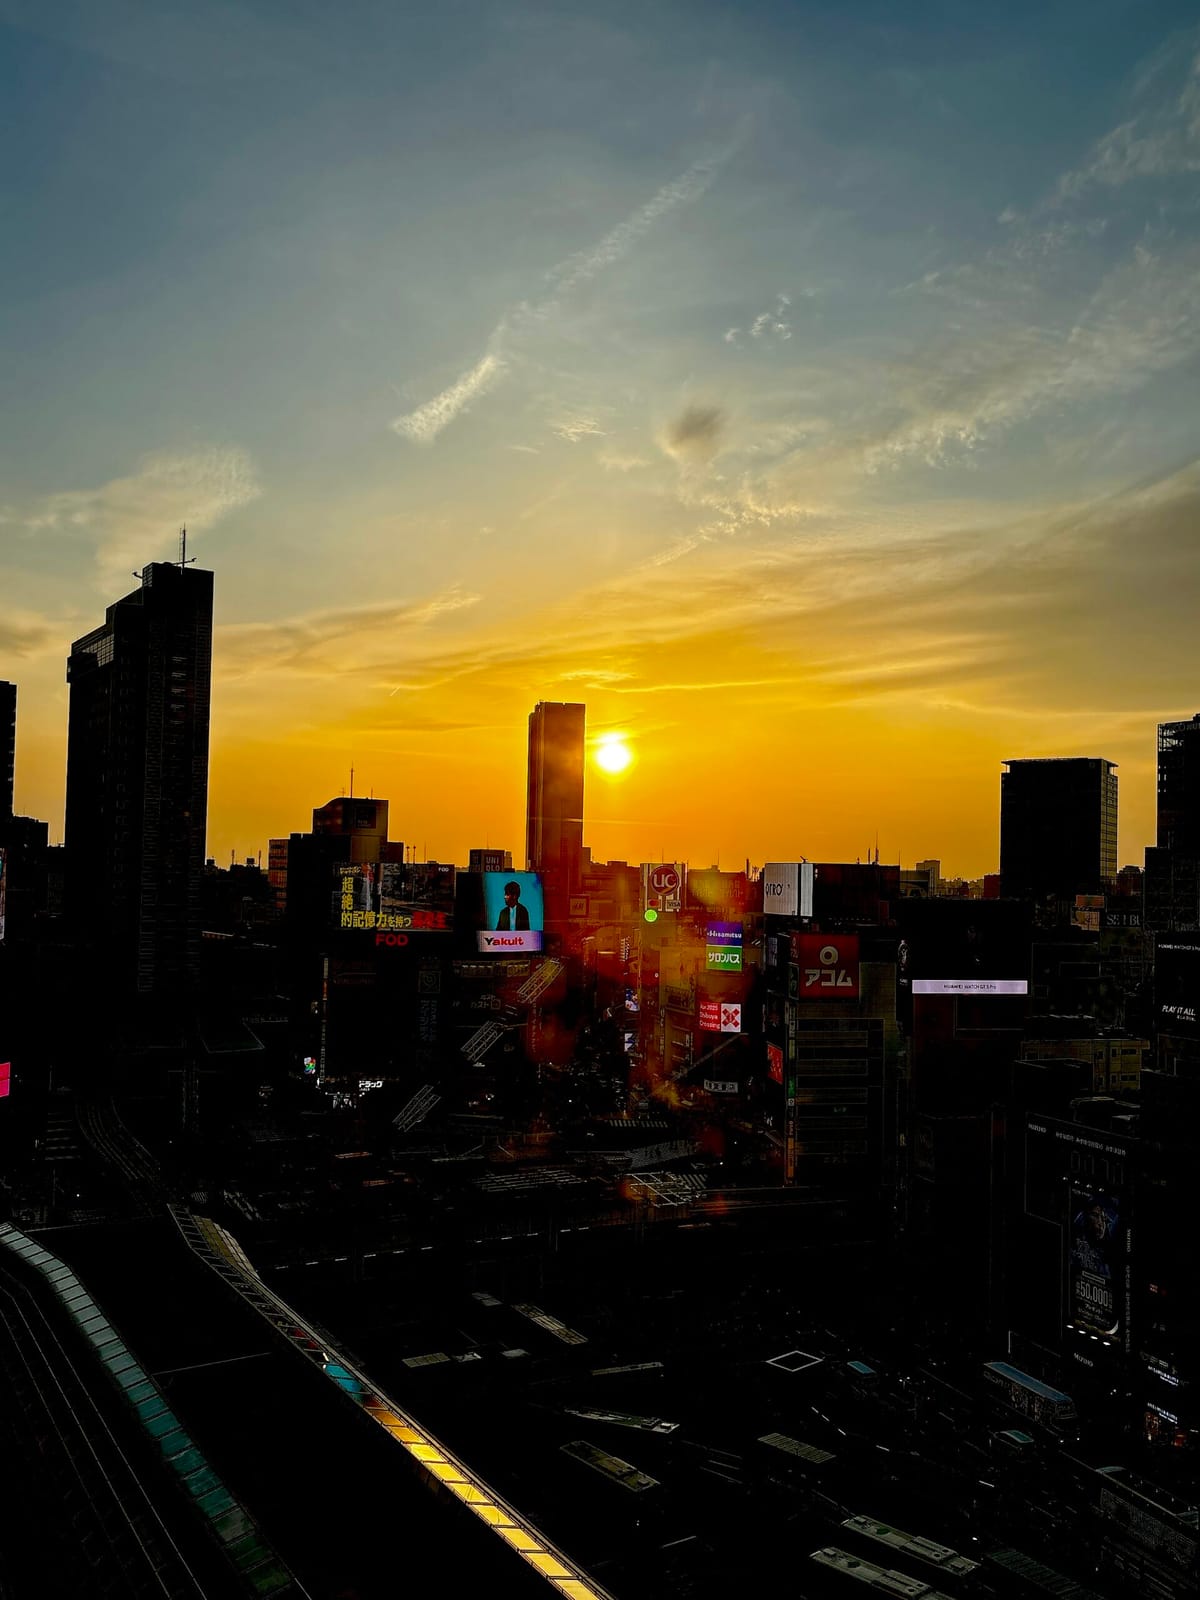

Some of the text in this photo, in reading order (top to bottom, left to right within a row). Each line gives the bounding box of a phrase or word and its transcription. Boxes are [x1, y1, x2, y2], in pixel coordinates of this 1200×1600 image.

[653, 874, 678, 888] UC
[375, 933, 409, 946] FOD
[484, 937, 524, 946] Yakult
[708, 951, 740, 964] サロンパス
[804, 968, 853, 987] アコム
[1161, 1004, 1177, 1013] PLAY
